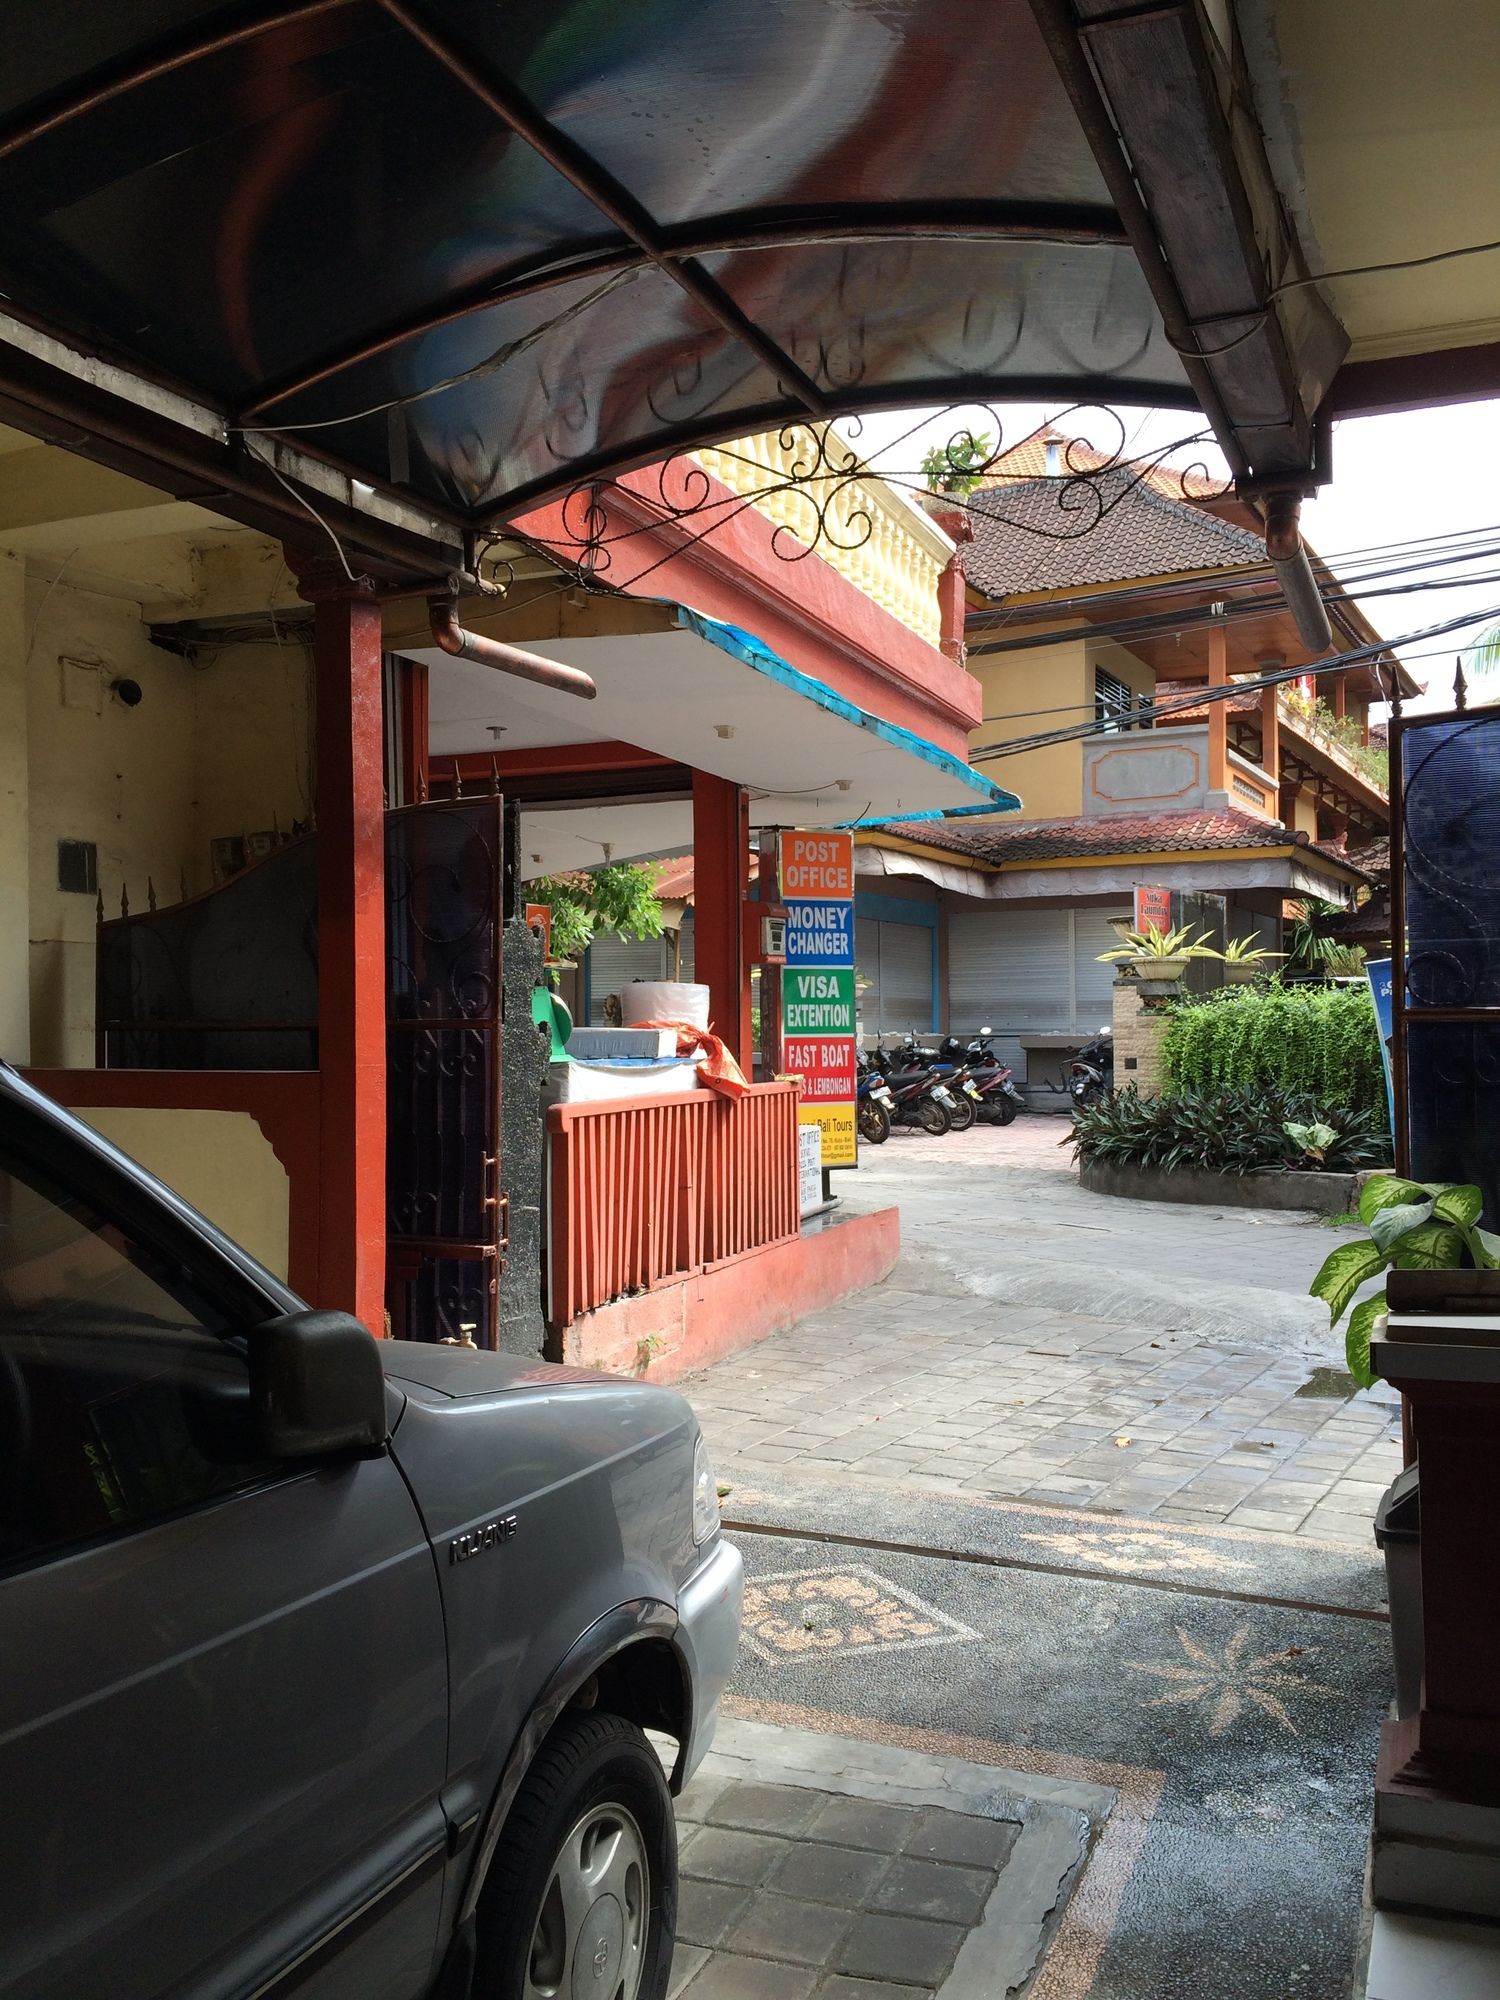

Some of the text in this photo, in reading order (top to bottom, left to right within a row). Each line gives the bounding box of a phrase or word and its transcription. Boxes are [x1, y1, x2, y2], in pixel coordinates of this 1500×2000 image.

[794, 840, 840, 863] POST
[786, 865, 849, 889] OFFICE
[788, 906, 849, 930] MONEY
[1140, 903, 1169, 916] Laundry
[787, 932, 849, 955] CHANGER
[797, 975, 840, 999] VISA
[787, 1004, 850, 1027] EXTENTION
[788, 1044, 850, 1068] FAST BOAT
[808, 1077, 813, 1096] &
[813, 1076, 851, 1096] LEMBONGAN
[832, 1118, 853, 1132] Tours
